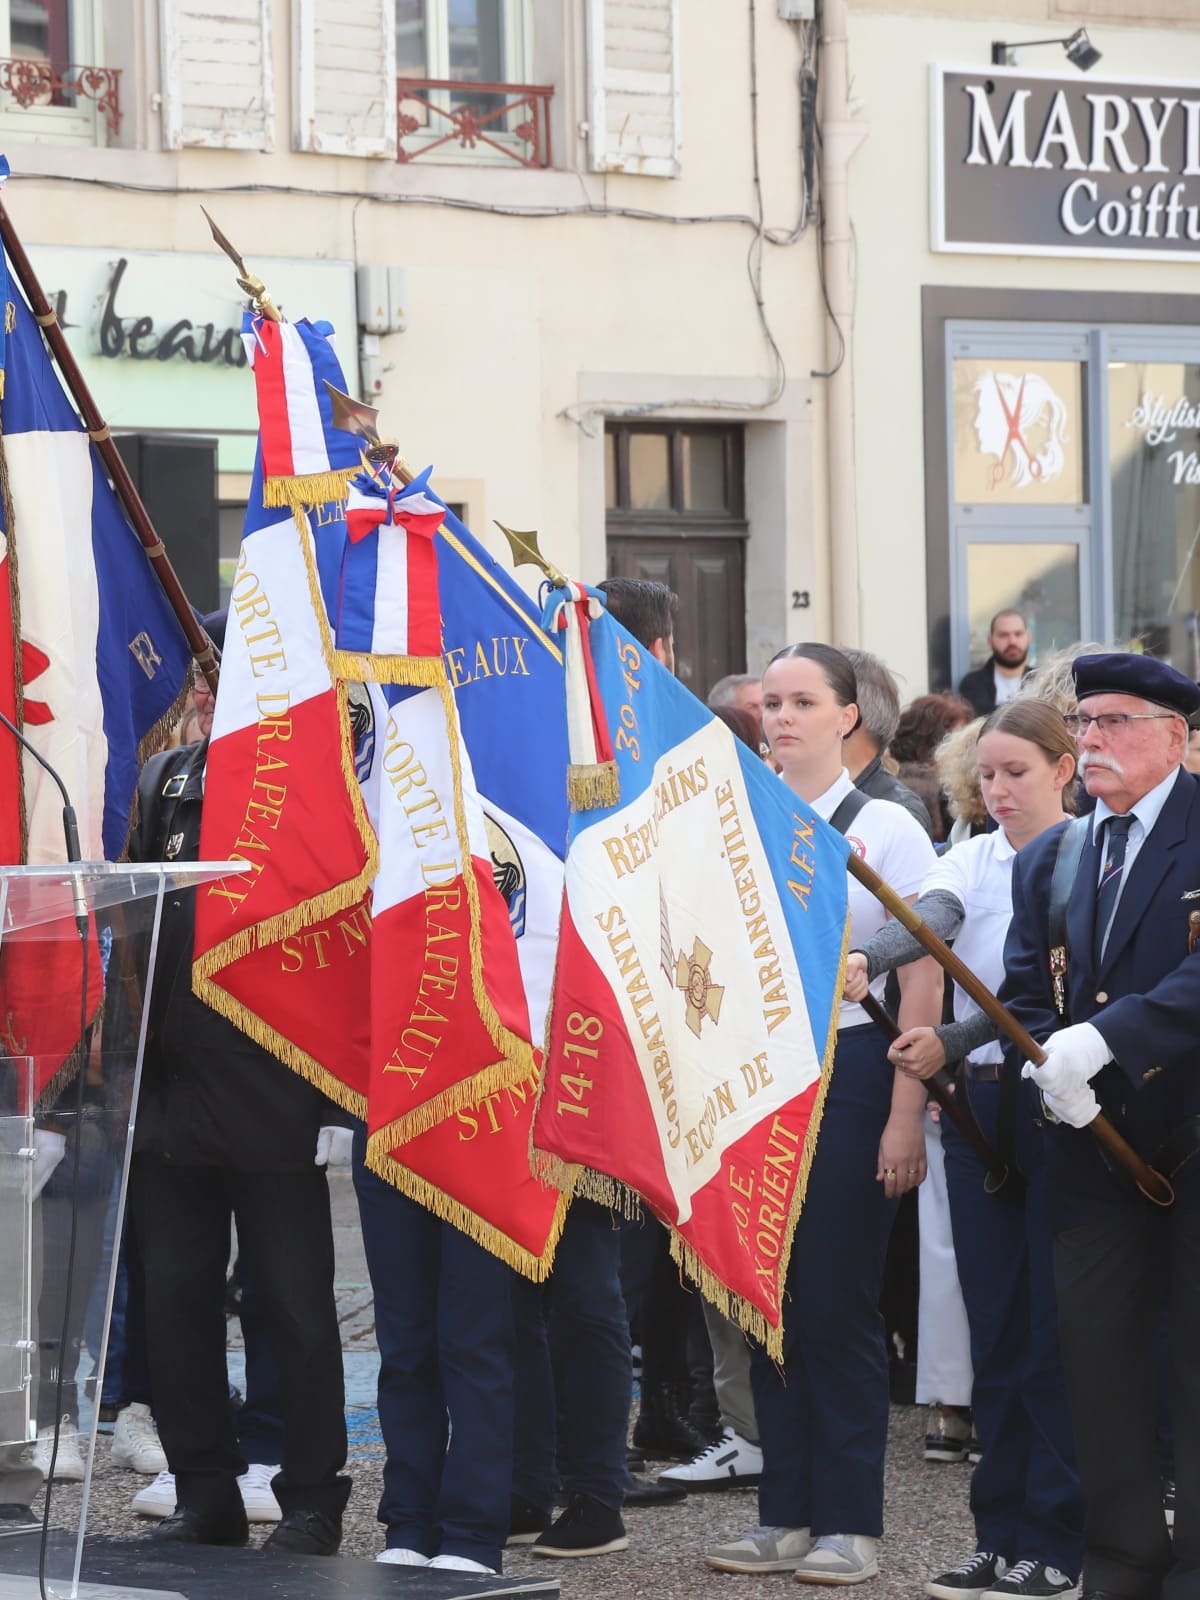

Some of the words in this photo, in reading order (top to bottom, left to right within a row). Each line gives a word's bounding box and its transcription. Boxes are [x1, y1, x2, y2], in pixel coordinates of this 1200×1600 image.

[100, 258, 247, 369] beau
[791, 589, 811, 610] 23
[445, 637, 531, 689] EAUX
[281, 930, 332, 973] ST
[382, 859, 463, 1091] DRAPEAUX
[556, 1011, 604, 1119] 14-18
[739, 1051, 774, 1098] DE
